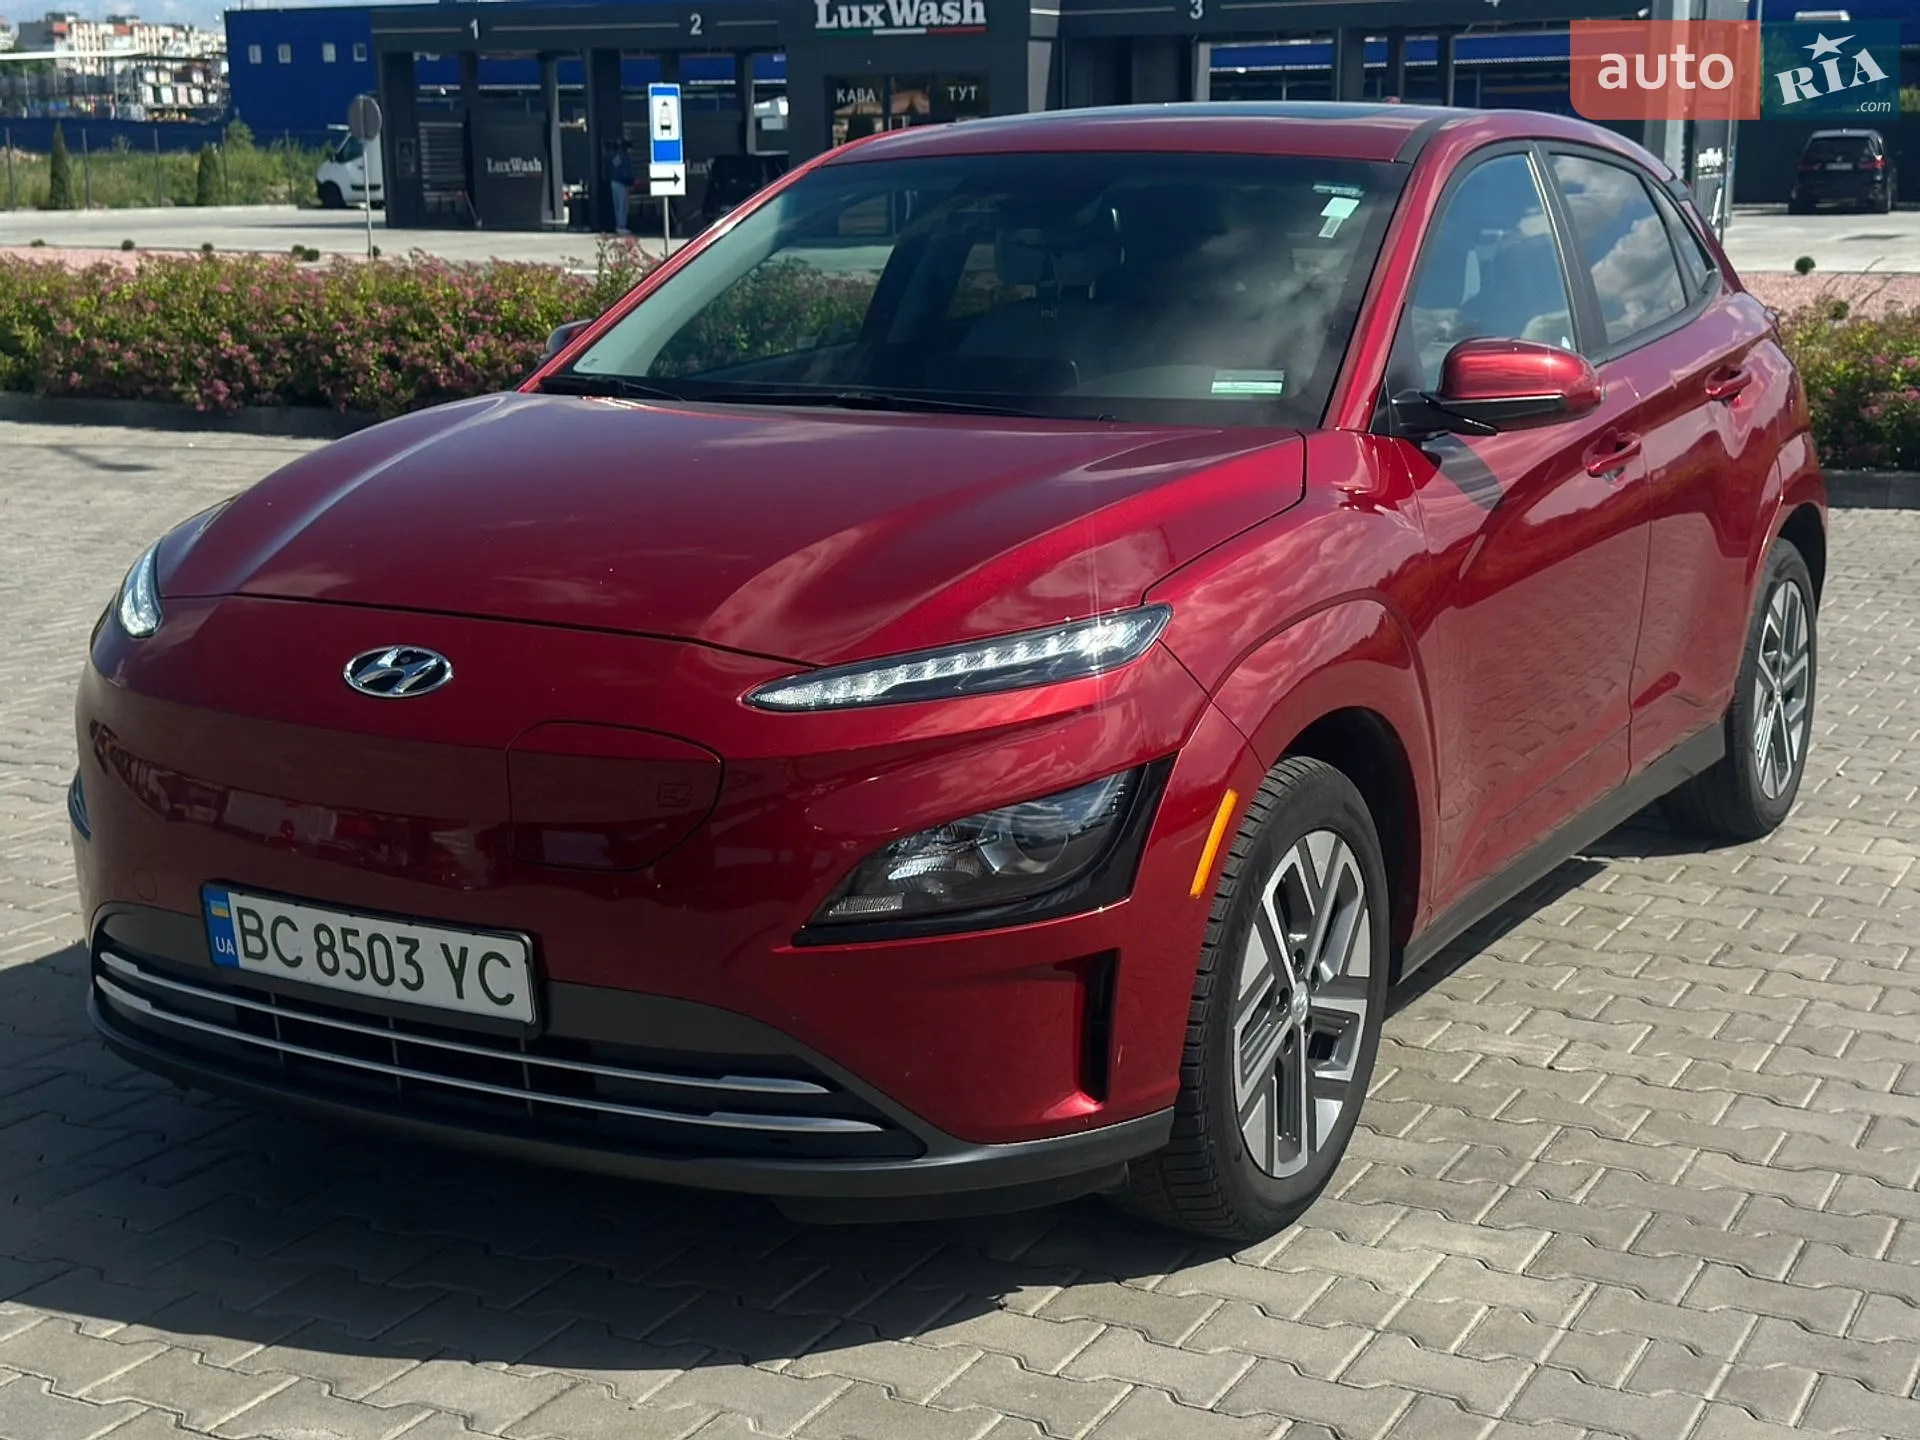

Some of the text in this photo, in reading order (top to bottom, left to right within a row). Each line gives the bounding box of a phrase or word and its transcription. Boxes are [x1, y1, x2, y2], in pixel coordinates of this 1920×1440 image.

[815, 0, 987, 29] LuxWash
[1190, 0, 1204, 20] 3
[469, 18, 479, 40] 1
[689, 13, 702, 35] 2
[836, 85, 979, 104] КАВА ТУТ
[486, 157, 543, 174] LuxWash
[215, 936, 236, 956] UA
[236, 906, 515, 1006] BC 8503 YC
